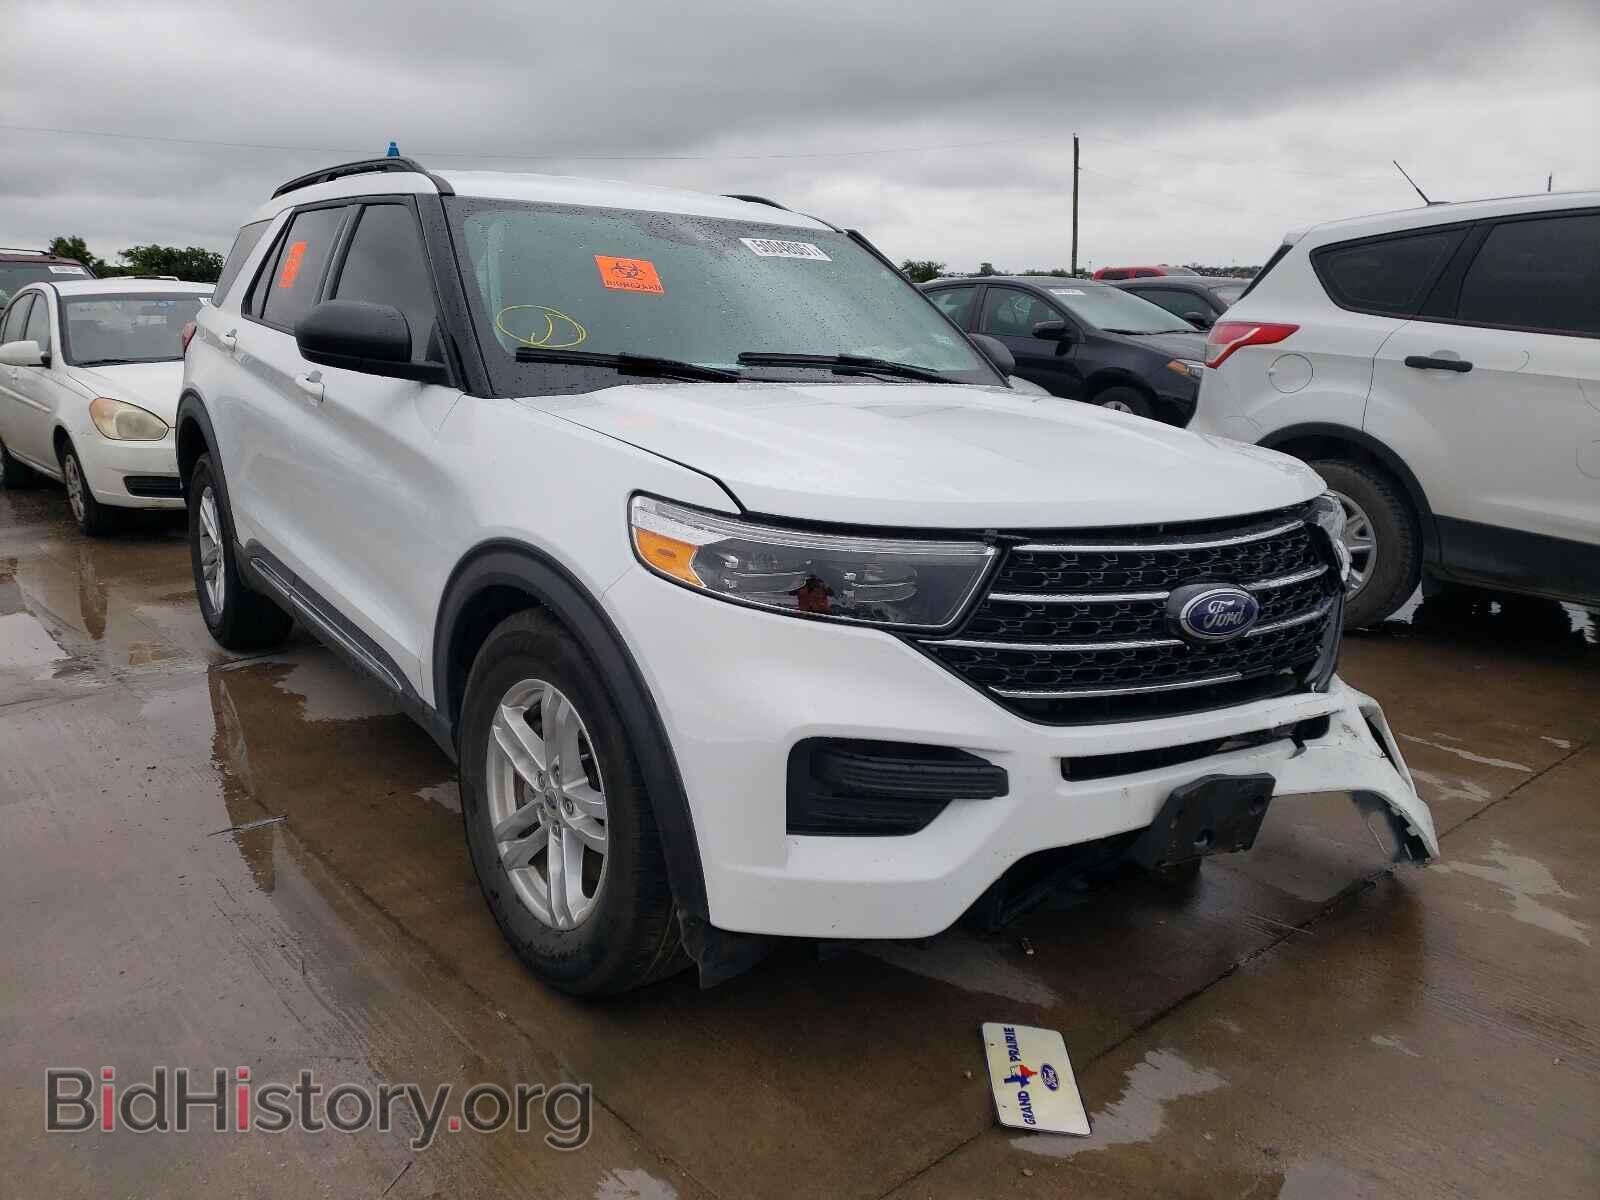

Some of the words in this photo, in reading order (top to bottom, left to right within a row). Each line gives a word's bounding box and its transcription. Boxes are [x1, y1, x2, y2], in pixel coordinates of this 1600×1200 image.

[1204, 599, 1246, 629] Ford
[1003, 1026, 1022, 1062] PRAIRIE
[1017, 1090, 1037, 1126] GRAND
